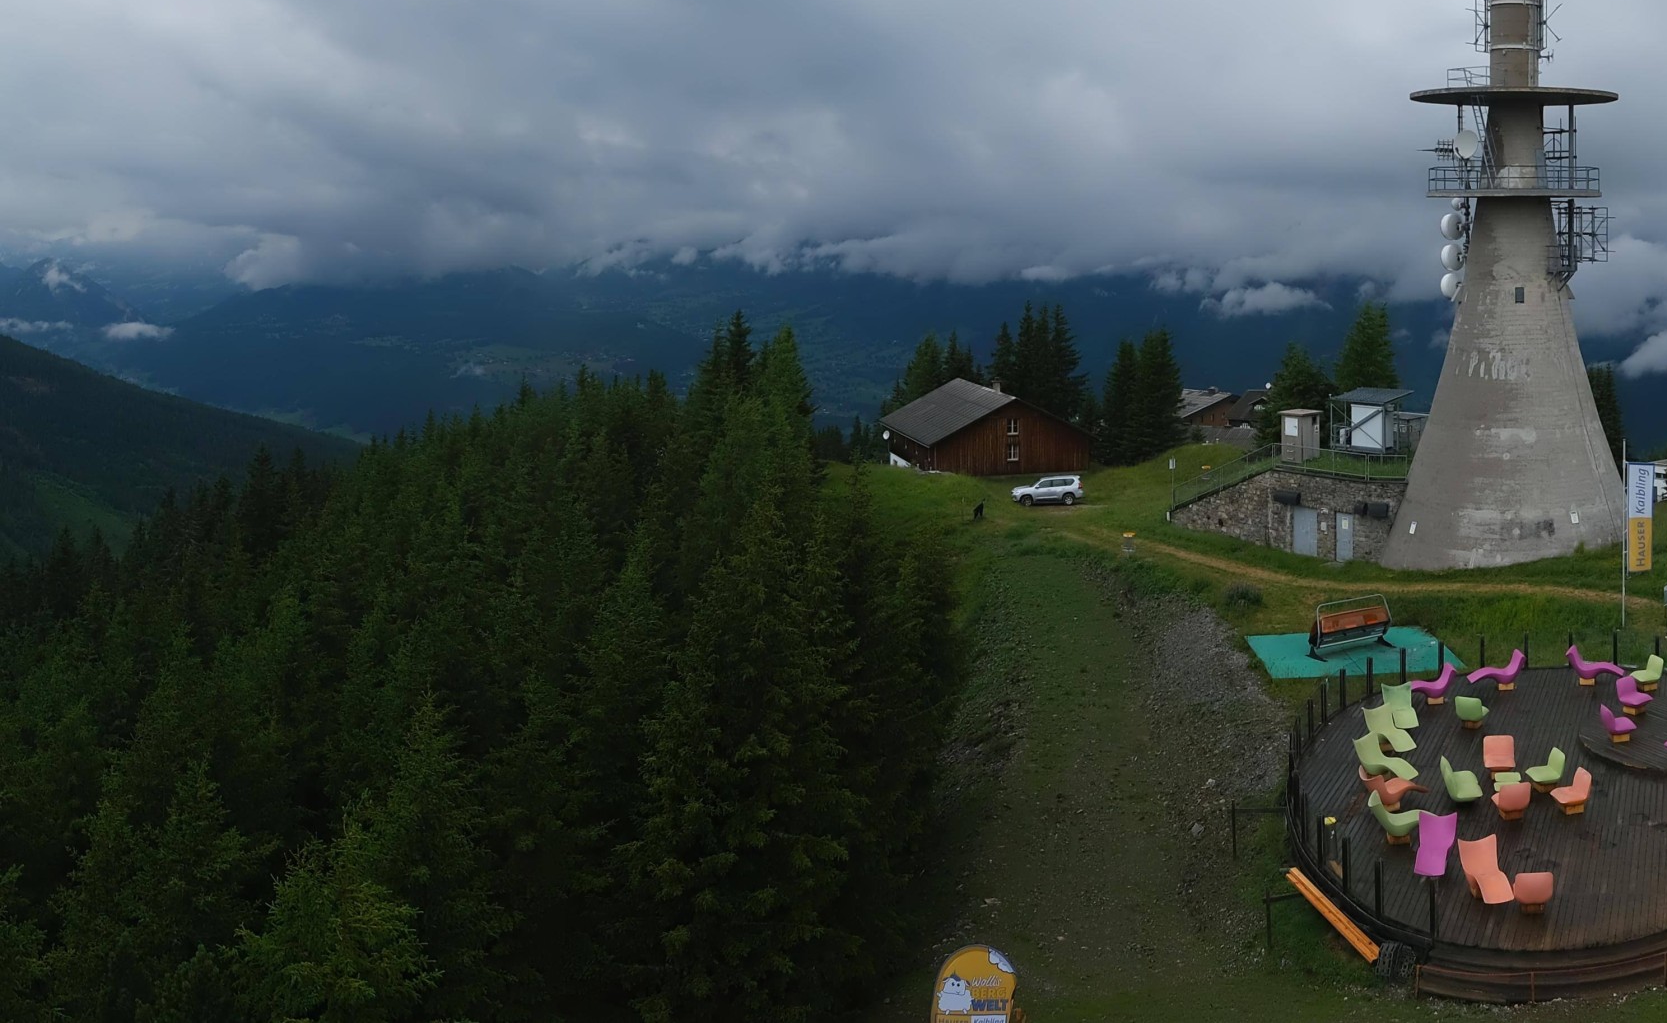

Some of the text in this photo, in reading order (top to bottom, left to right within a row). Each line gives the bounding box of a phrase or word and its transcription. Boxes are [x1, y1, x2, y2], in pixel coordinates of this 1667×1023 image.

[1636, 468, 1649, 566] HAUSER Kaibling
[971, 975, 1001, 987] Wollis
[972, 987, 1007, 997] BERG
[971, 999, 1008, 1011] WELT
